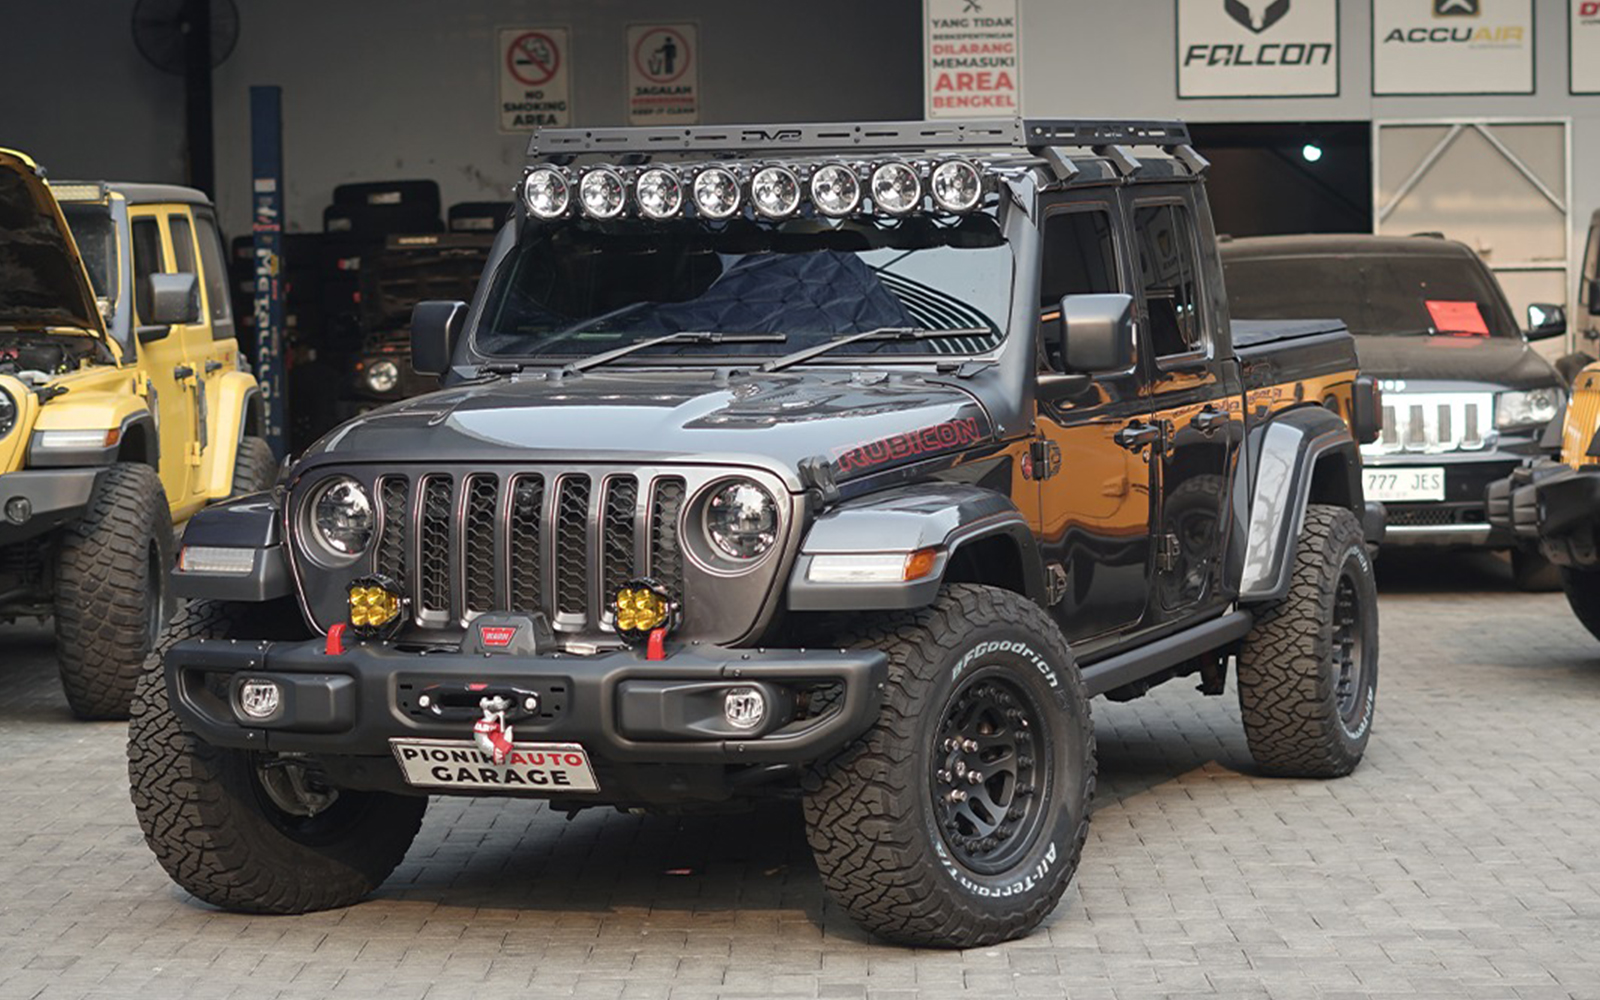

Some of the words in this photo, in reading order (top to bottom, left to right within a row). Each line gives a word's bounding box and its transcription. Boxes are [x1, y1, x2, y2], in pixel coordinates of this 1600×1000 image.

[932, 19, 969, 28] YANG
[973, 18, 1014, 27] TIDAK
[1384, 26, 1525, 44] ACCUAIR
[932, 42, 1014, 55] DILARANG
[1183, 44, 1332, 66] FALCON
[932, 57, 1015, 68] MEMASUKI
[934, 71, 1015, 92] AREA
[524, 90, 544, 99] NO
[933, 95, 1015, 109] BENGKEL
[503, 101, 566, 112] SMOKING
[513, 113, 558, 126] AREA
[832, 417, 981, 472] RUBICON
[1368, 474, 1398, 490] 777
[1411, 474, 1440, 490] JES
[951, 639, 1059, 688] BFGoodrich
[510, 752, 583, 767] AUTO
[431, 766, 571, 786] GARAGE
